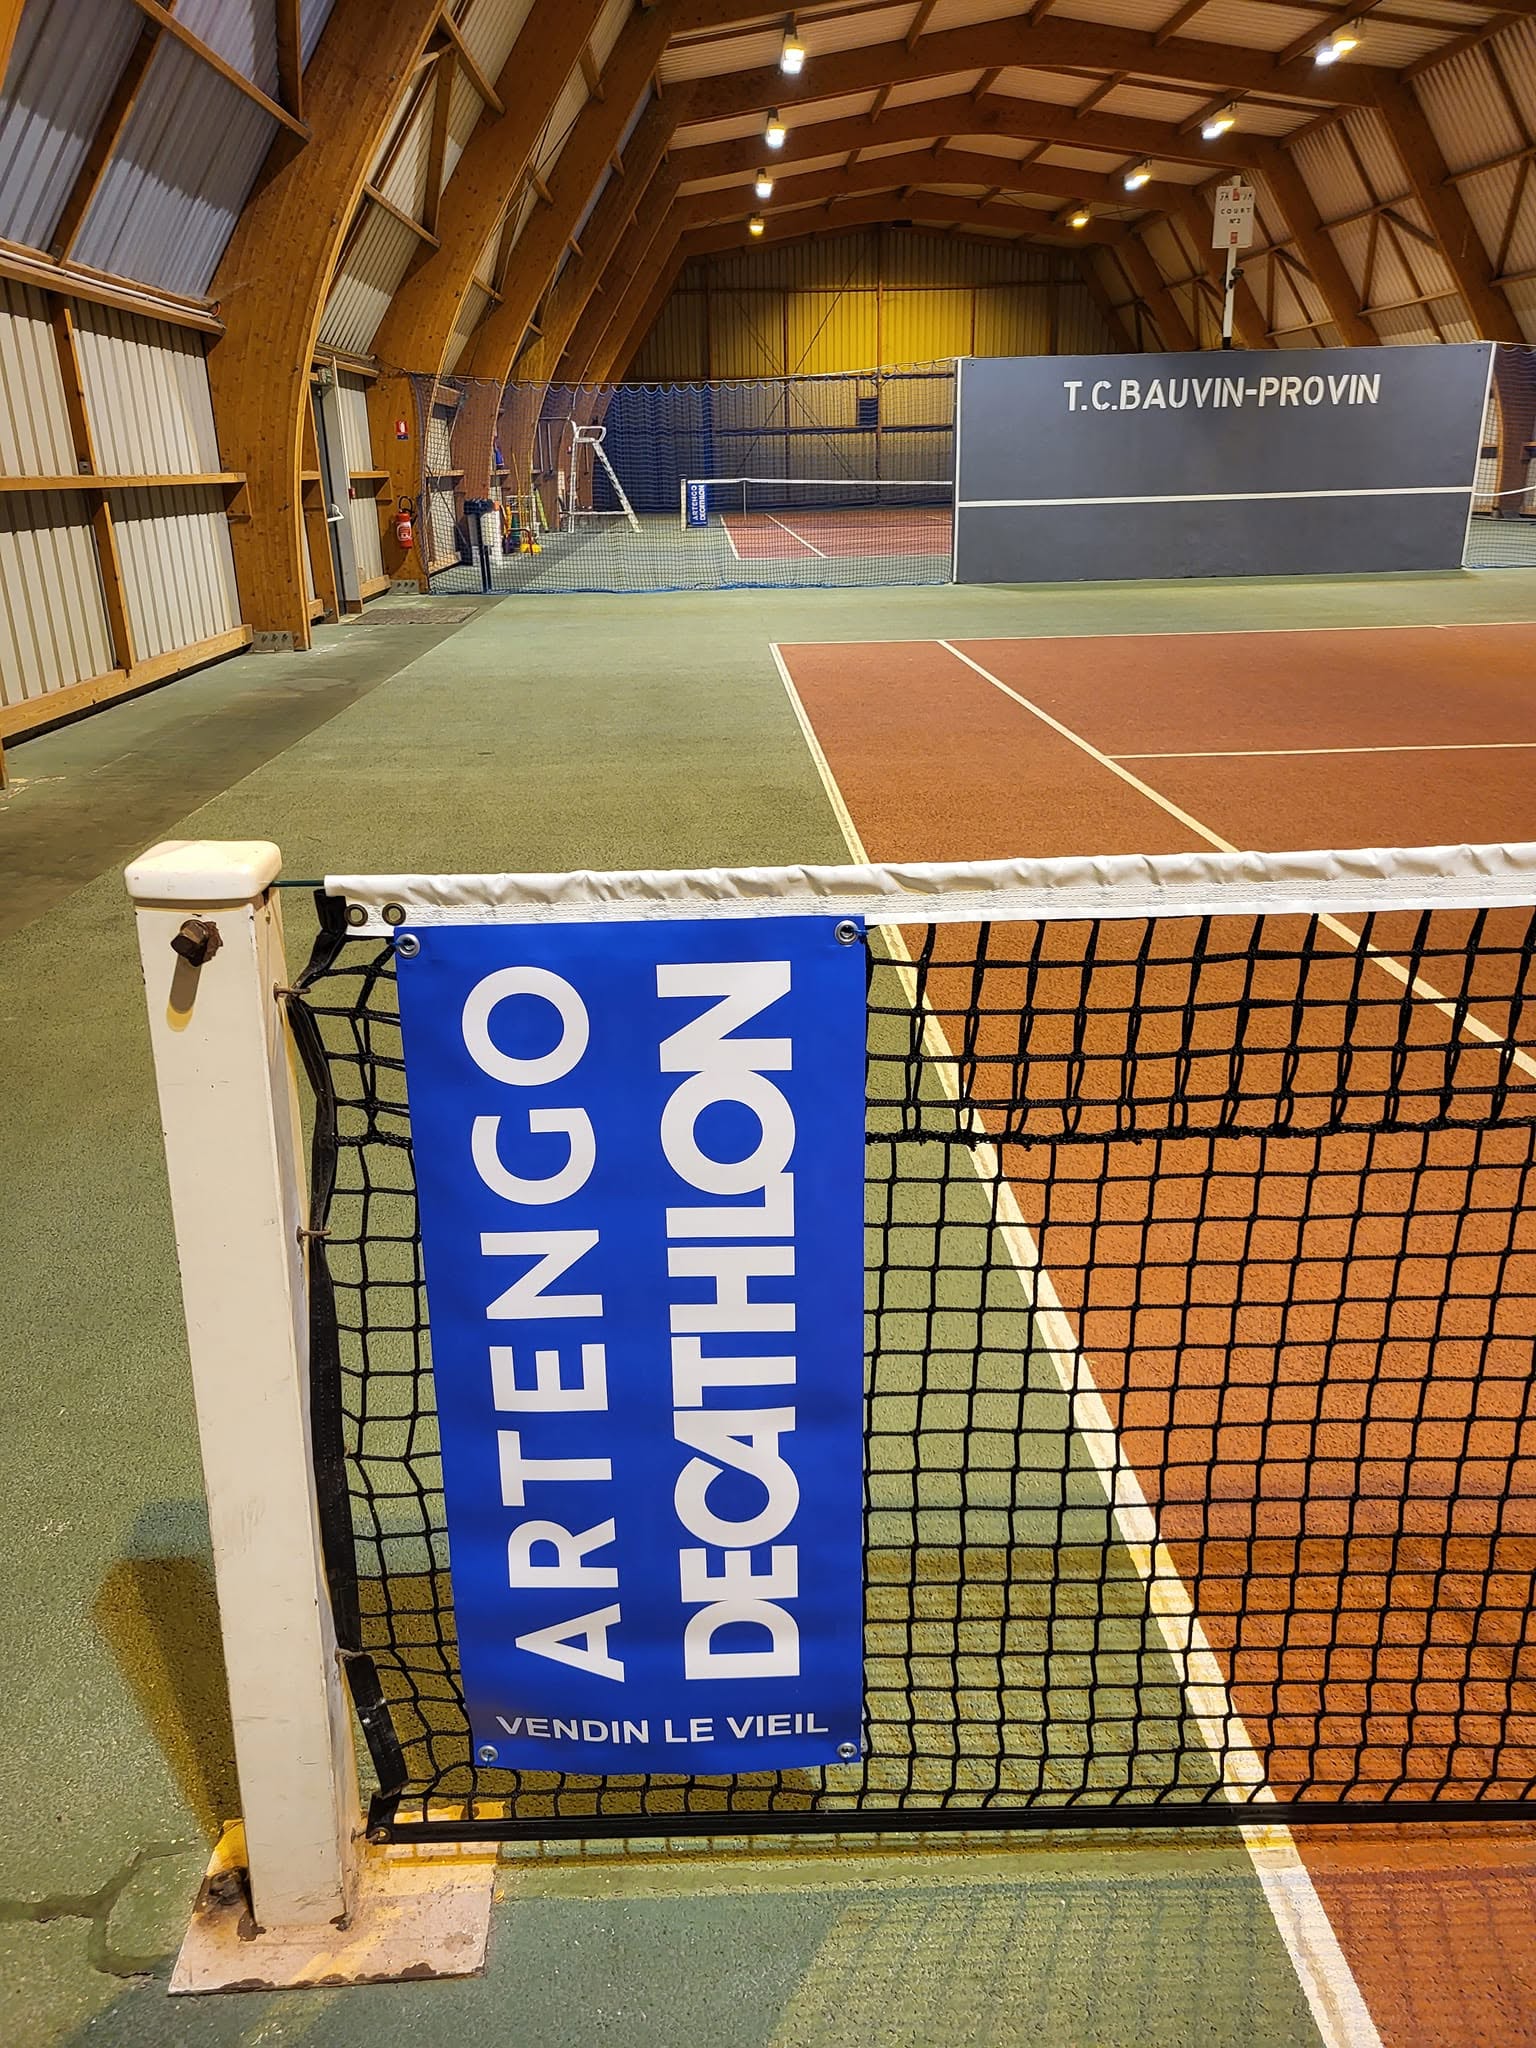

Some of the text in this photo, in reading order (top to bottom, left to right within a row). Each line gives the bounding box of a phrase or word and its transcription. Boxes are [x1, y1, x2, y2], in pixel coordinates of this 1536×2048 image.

[1063, 373, 1381, 411] T.C.BAUVIN-PROVIN
[462, 966, 626, 1682] ARTENGO
[656, 960, 801, 1680] DECATHLON
[497, 1713, 829, 1745] VENDIN LE VIEIL
